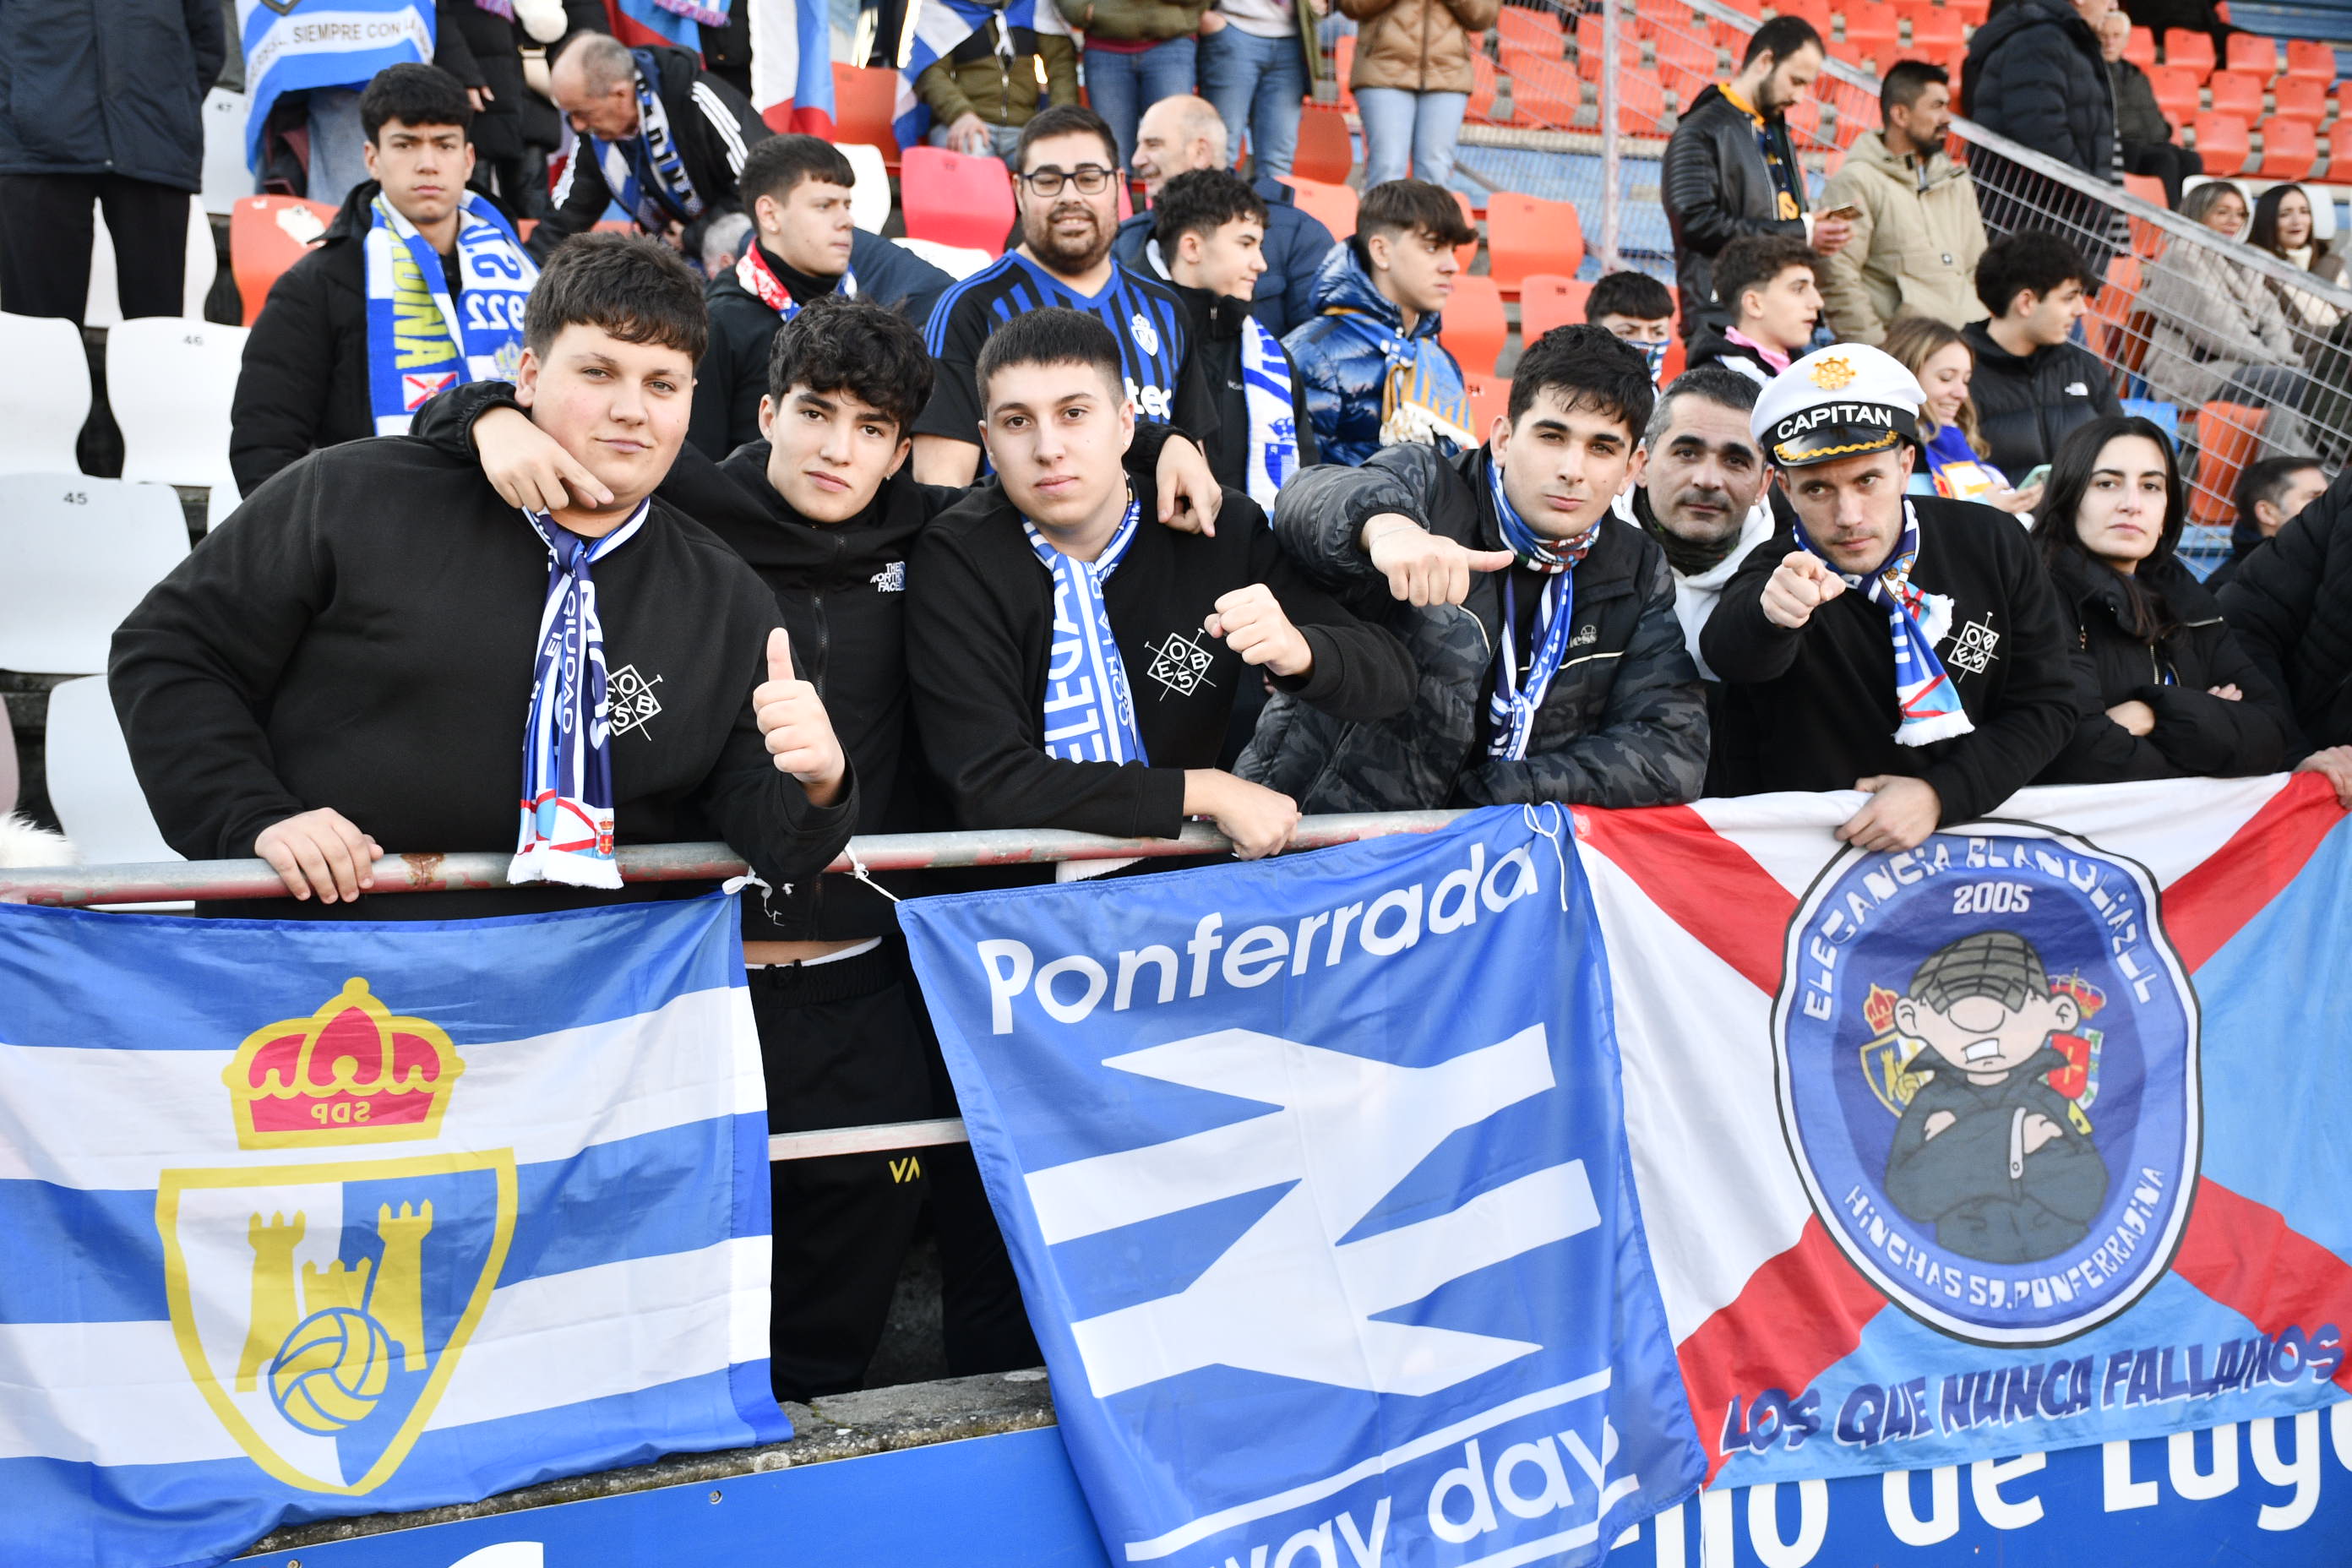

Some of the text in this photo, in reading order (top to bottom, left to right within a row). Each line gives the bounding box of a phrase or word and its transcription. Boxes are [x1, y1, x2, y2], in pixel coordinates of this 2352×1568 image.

[293, 23, 362, 44] SIEMPRE
[367, 23, 400, 39] CON
[1777, 405, 1892, 440] CAPITAN
[63, 492, 88, 505] 45
[869, 571, 903, 584] NORTH
[885, 562, 901, 574] THE
[878, 582, 901, 592] FACE
[563, 590, 577, 734] CIUDAD
[1043, 564, 1101, 764] ELEGA
[1952, 880, 2034, 914] 2005
[977, 841, 1539, 1036] Ponferrada
[1718, 1323, 2342, 1456] LOS QUE NUNCA FALLAMOS
[2103, 1398, 2352, 1532] Lug
